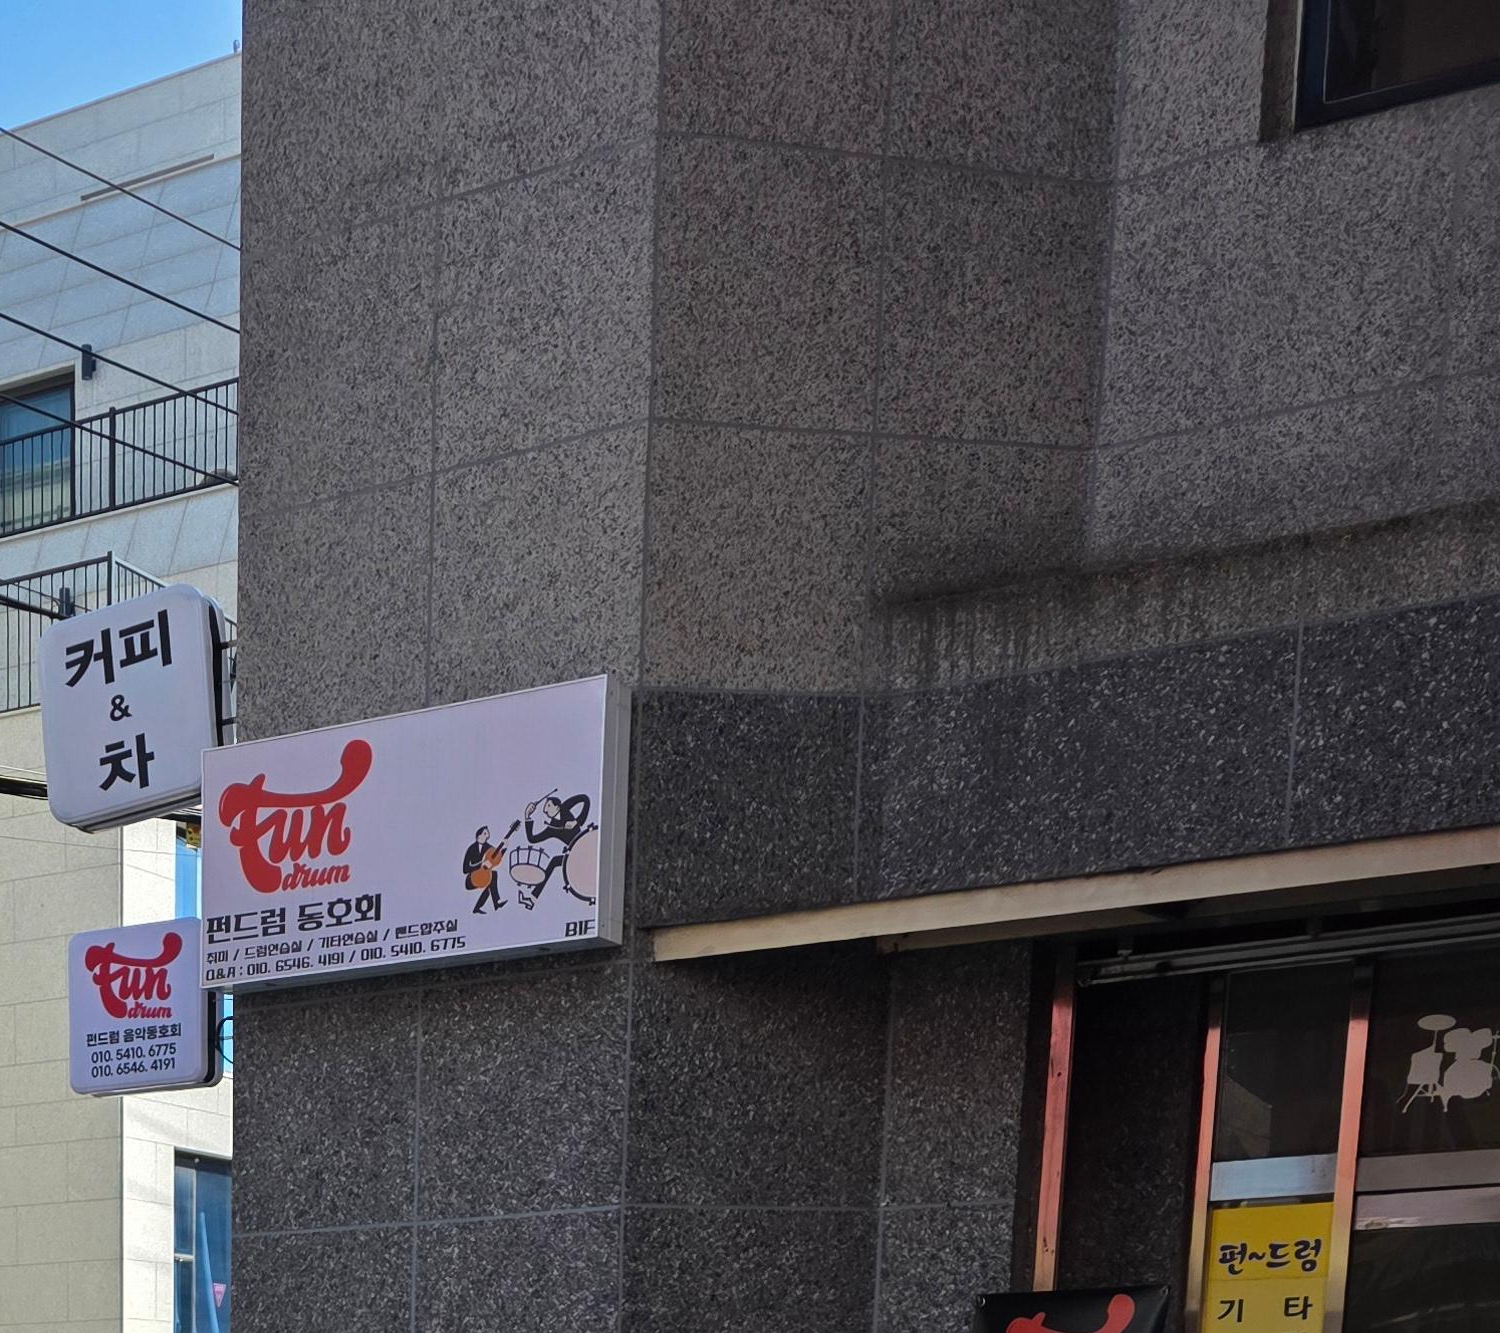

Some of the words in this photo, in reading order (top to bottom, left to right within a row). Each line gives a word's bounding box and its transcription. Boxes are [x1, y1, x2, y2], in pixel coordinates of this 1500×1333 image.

[65, 609, 172, 687] 커피
[110, 694, 132, 721] &
[100, 732, 155, 791] 차
[282, 862, 350, 891] drum
[206, 907, 286, 944] 펀드럼
[297, 893, 382, 932] 동호회
[206, 949, 228, 965] 취미
[244, 940, 302, 960] 드럼연습실
[318, 929, 378, 949] 기타연습실
[247, 962, 271, 976] 010.
[275, 956, 313, 971] 6546.
[318, 952, 344, 966] 4191
[361, 947, 386, 961] 010.
[391, 941, 426, 957] 5410.
[431, 936, 466, 952] 6775
[127, 1001, 172, 1019] drum
[86, 1030, 120, 1047] 펀드럼
[123, 1023, 182, 1043] 음악동호회
[91, 1051, 113, 1064] 010.
[116, 1046, 145, 1060] 5410.
[148, 1042, 176, 1057] 6775
[91, 1065, 113, 1078] 010.
[116, 1061, 147, 1075] 6546.
[151, 1057, 175, 1071] 4191
